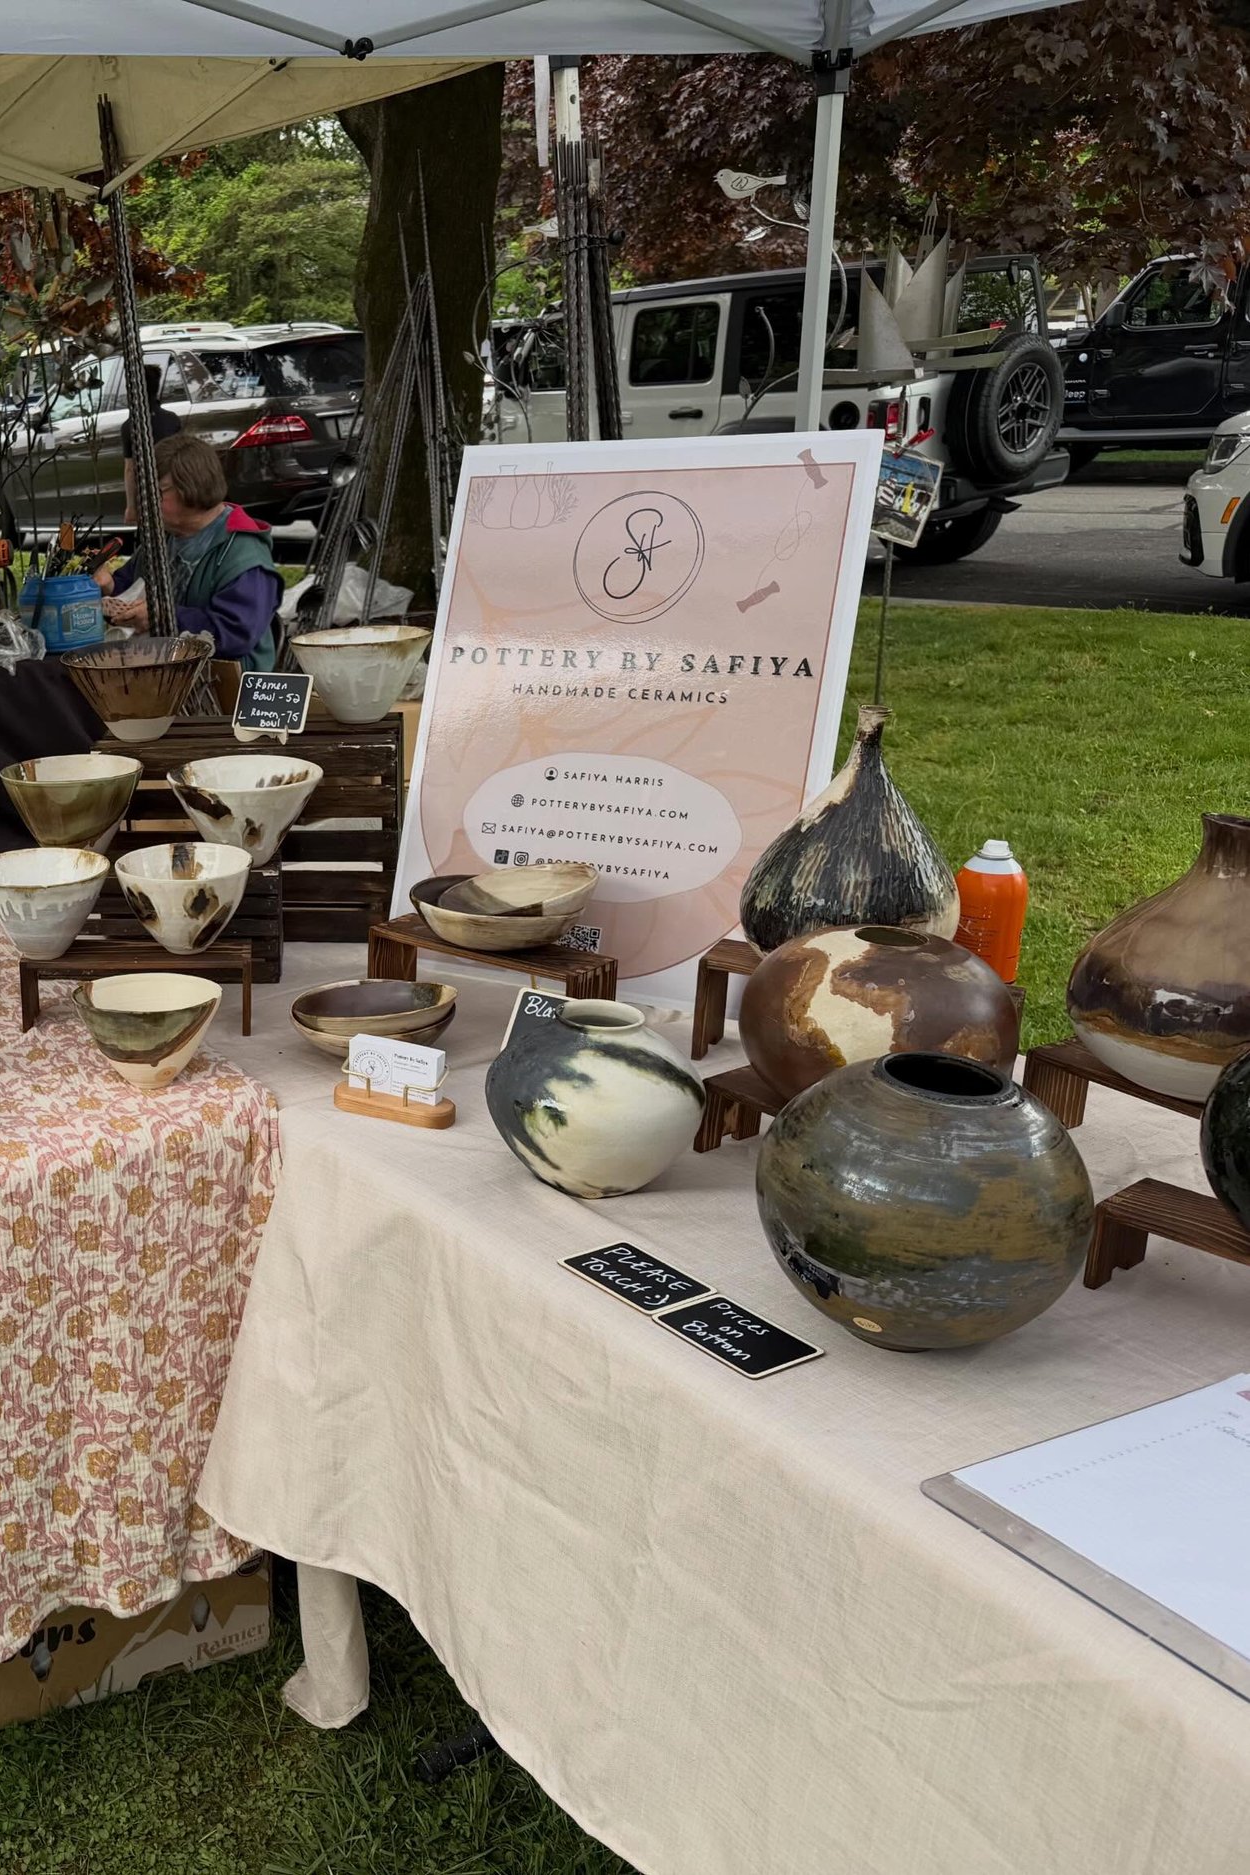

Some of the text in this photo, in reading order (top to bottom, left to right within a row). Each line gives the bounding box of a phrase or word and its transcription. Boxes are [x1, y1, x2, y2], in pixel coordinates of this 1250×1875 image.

[449, 646, 814, 677] POTTERY BY SAFIYA
[245, 677, 287, 690] S Ramen
[512, 684, 730, 704] HANDMADE CERAMICS
[237, 710, 246, 719] L
[250, 707, 279, 719] Ramen
[564, 771, 664, 787] SAFIYA HARRIS
[531, 798, 688, 820] POTTERYBYSAFIYA.COM
[501, 824, 718, 854] SAFIYA@POTTERYBYSAFIYA.COM
[535, 857, 669, 879] @PYBYSAFIYA
[581, 1256, 651, 1294] TOUCH
[604, 1246, 693, 1291] PLEASE
[709, 1302, 771, 1337] Prices
[719, 1324, 744, 1339] on
[682, 1319, 751, 1362] Bottom
[196, 1621, 266, 1660] Rainier
